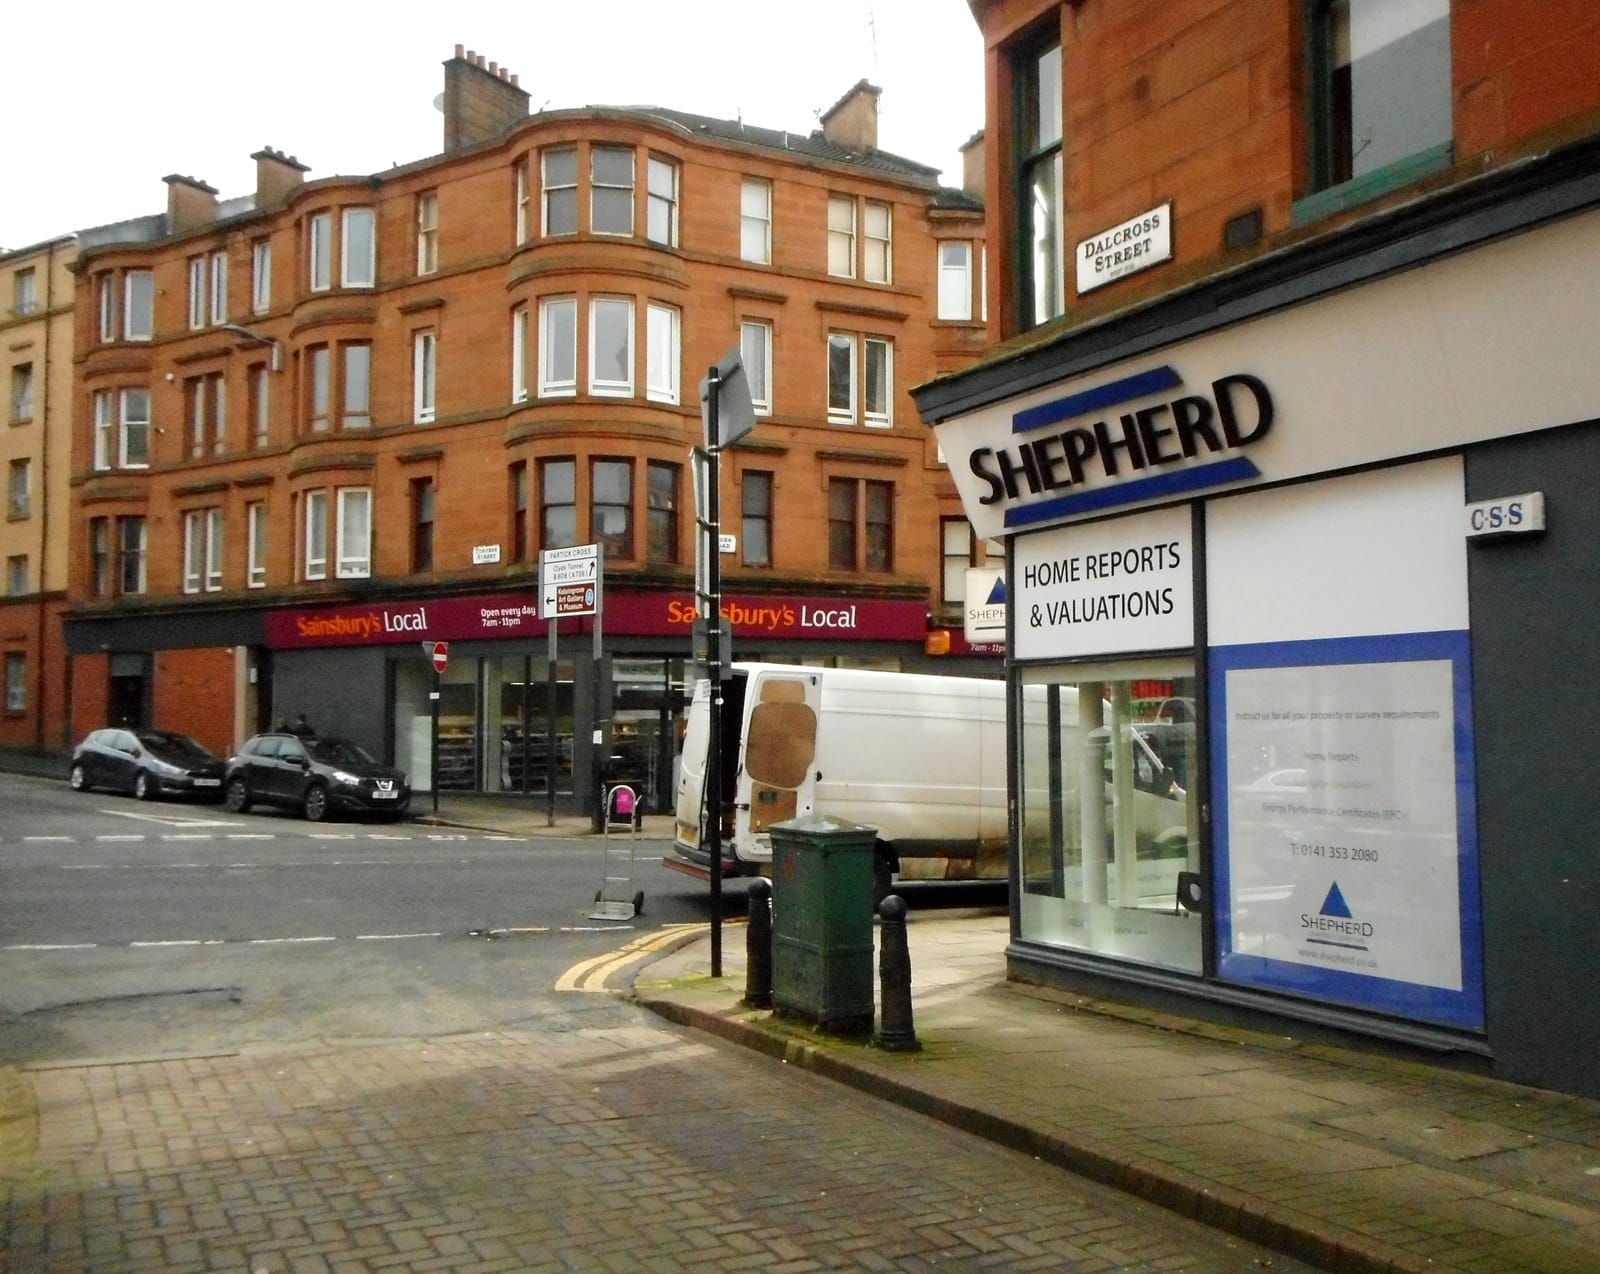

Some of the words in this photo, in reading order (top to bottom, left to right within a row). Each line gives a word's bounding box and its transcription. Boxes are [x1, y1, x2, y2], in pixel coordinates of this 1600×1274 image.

[1085, 214, 1160, 259] DALCROSS
[1095, 237, 1152, 273] STREET
[968, 373, 1274, 506] SHEPHERD
[572, 547, 592, 556] CROSS
[1025, 557, 1081, 589] HOME
[1086, 541, 1181, 580] REPORTS
[480, 608, 500, 619] Open
[500, 607, 521, 617] every
[521, 604, 536, 617] day
[667, 601, 795, 630] Sasbury's
[801, 605, 857, 628] Local
[969, 609, 1006, 620] SHEPH
[1030, 603, 1043, 628] &
[1046, 587, 1174, 626] VALUATIONS
[297, 612, 381, 638] Sainsbury's
[384, 607, 428, 632] Local
[481, 618, 498, 627] 7am
[502, 617, 521, 628] 11pm
[970, 643, 987, 652] 7am
[991, 643, 1006, 654] 11p
[1327, 751, 1359, 763] Reports
[1301, 844, 1326, 857] 0141
[1329, 846, 1348, 860] 353
[1351, 848, 1378, 863] 2080
[1301, 913, 1374, 937] SHEPHERD
